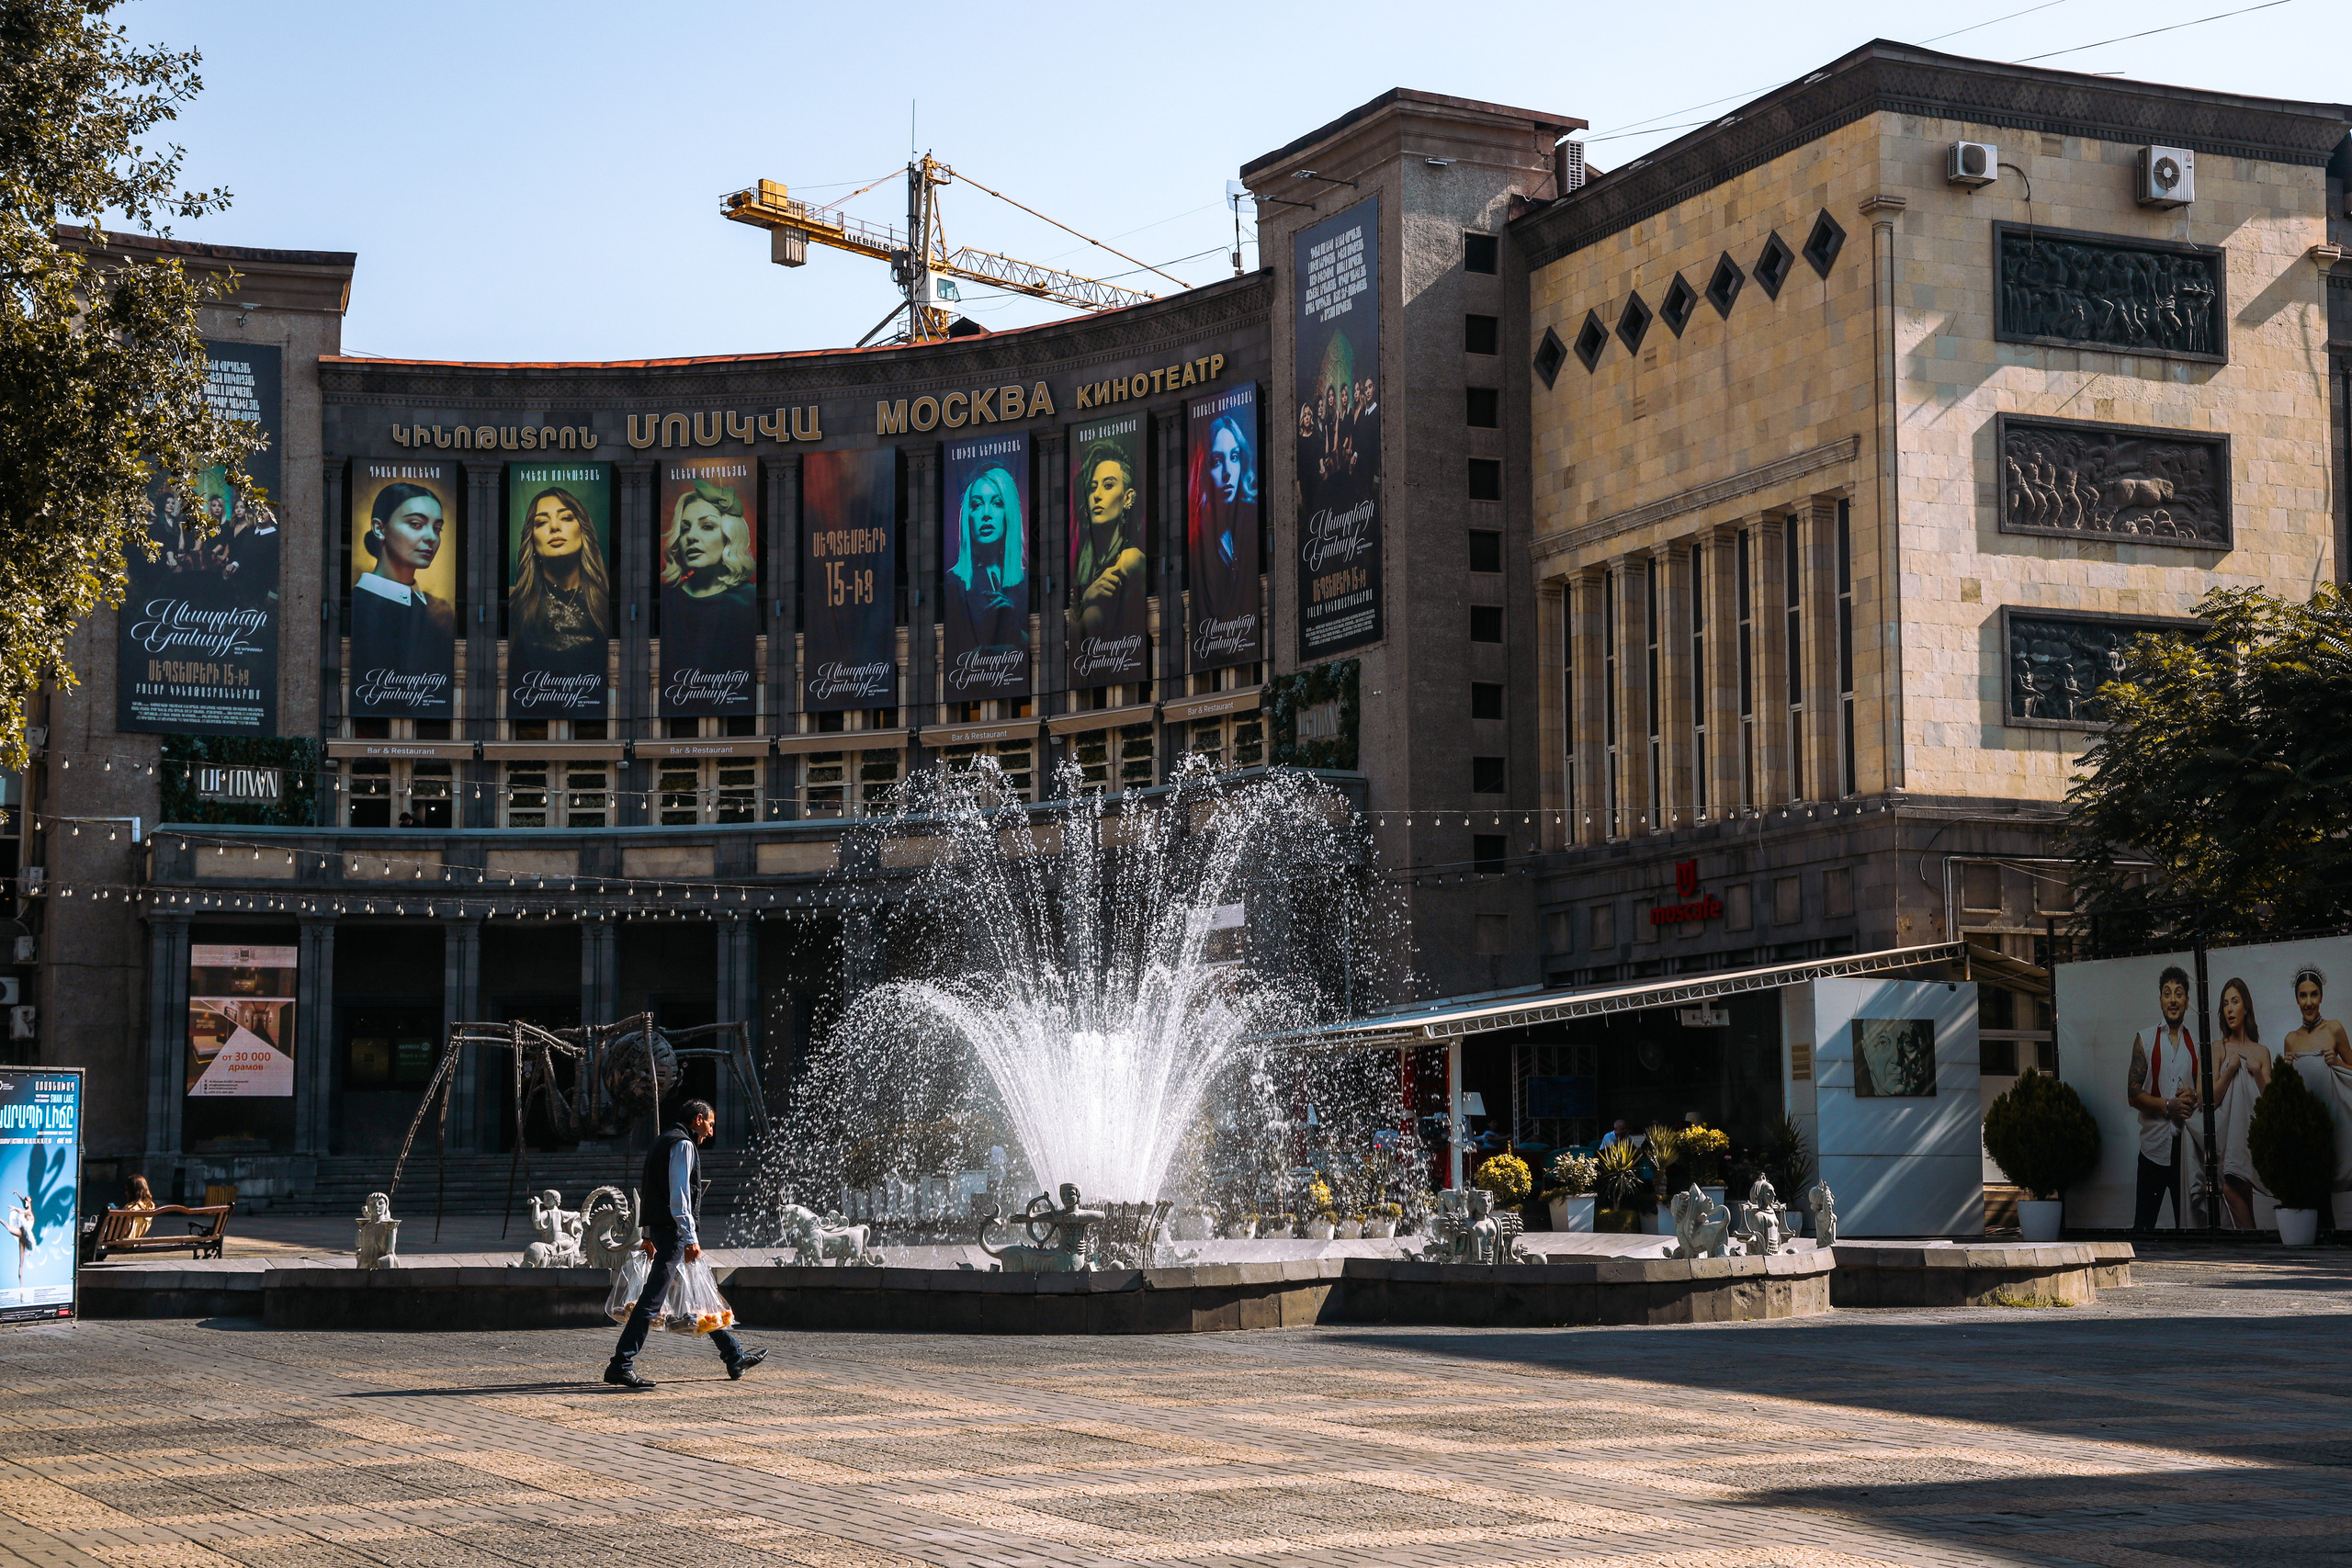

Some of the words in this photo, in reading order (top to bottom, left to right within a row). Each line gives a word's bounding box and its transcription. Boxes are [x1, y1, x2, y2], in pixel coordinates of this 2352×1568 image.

[876, 380, 1056, 435] МОСКВА
[1077, 353, 1226, 410] КИНОТЕАТР
[391, 423, 598, 450] ԿԻՆՈԹԱՏՐՈՆ
[627, 404, 823, 449] ՄՈՍԿՎԱ
[813, 526, 886, 558] ՍԵՊՏԵՄԲԵՐԻ
[148, 660, 220, 685] ՍԵՊՏԵՄԲԵՐԻ
[1187, 707, 1198, 716] Bar
[1204, 701, 1235, 714] Restaurant
[951, 733, 964, 741] Bar
[965, 732, 970, 740] &
[970, 729, 1008, 740] Restaurant
[390, 747, 435, 755] Restaurant
[684, 746, 691, 754] &
[692, 746, 733, 754] Restaurant
[200, 768, 277, 798] UPTOWN
[1650, 893, 1724, 926] moscafe
[234, 1052, 249, 1061] 30
[251, 1052, 271, 1061] 000
[50, 1093, 62, 1103] SWAN
[63, 1094, 74, 1103] LAKE
